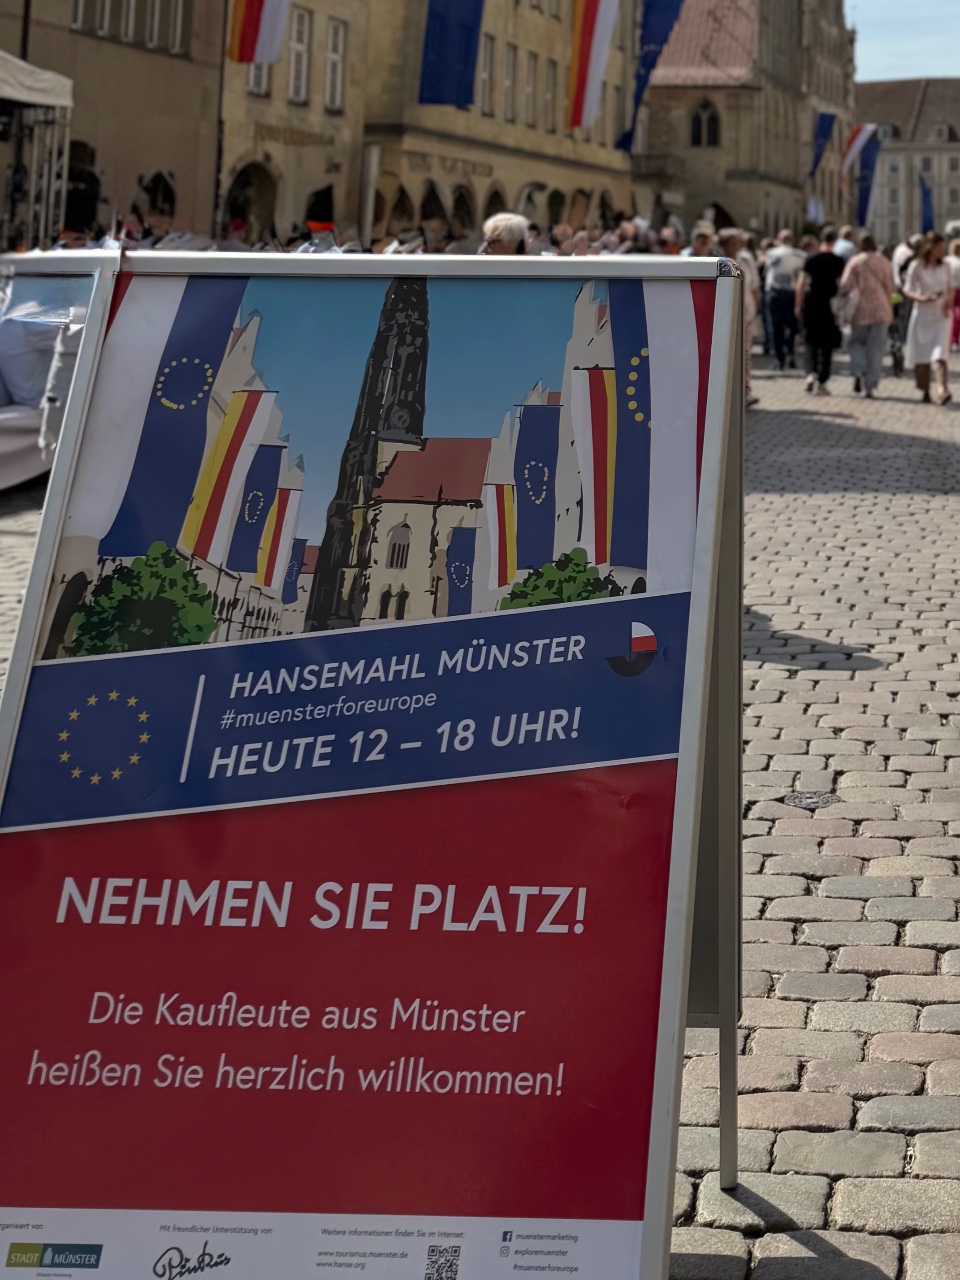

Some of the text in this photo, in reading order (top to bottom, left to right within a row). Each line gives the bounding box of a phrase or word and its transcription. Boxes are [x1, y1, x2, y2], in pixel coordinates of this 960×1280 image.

[229, 635, 586, 699] HANSEMAHL MÜNSTER
[220, 691, 437, 730] #muensterforeurope
[208, 734, 335, 779] HEUTE
[349, 728, 388, 764] 12
[436, 719, 475, 754] 18
[491, 706, 581, 747] UHR!
[55, 877, 588, 935] NEHMEN SIE PLATZ!
[88, 991, 526, 1033] Die Kaufleute aus Münster
[27, 1050, 566, 1097] heißen Sie herzlich willkommen!
[0, 1223, 30, 1231] rganisiert
[172, 1224, 211, 1233] freundlicher
[212, 1225, 259, 1236] Unterstützung
[321, 1228, 347, 1236] Weitere
[348, 1229, 393, 1238] Informationen
[394, 1229, 415, 1238] finden
[416, 1230, 426, 1238] Sie
[515, 1232, 579, 1243] muenstermarketing
[10, 1251, 98, 1265] STADT MÜNSTER
[317, 1250, 409, 1260] www.tourismus.muenster.de
[514, 1248, 569, 1257] exploremuenster
[315, 1261, 367, 1270] www.hanse.org
[512, 1263, 580, 1274] #muensterforeurope
